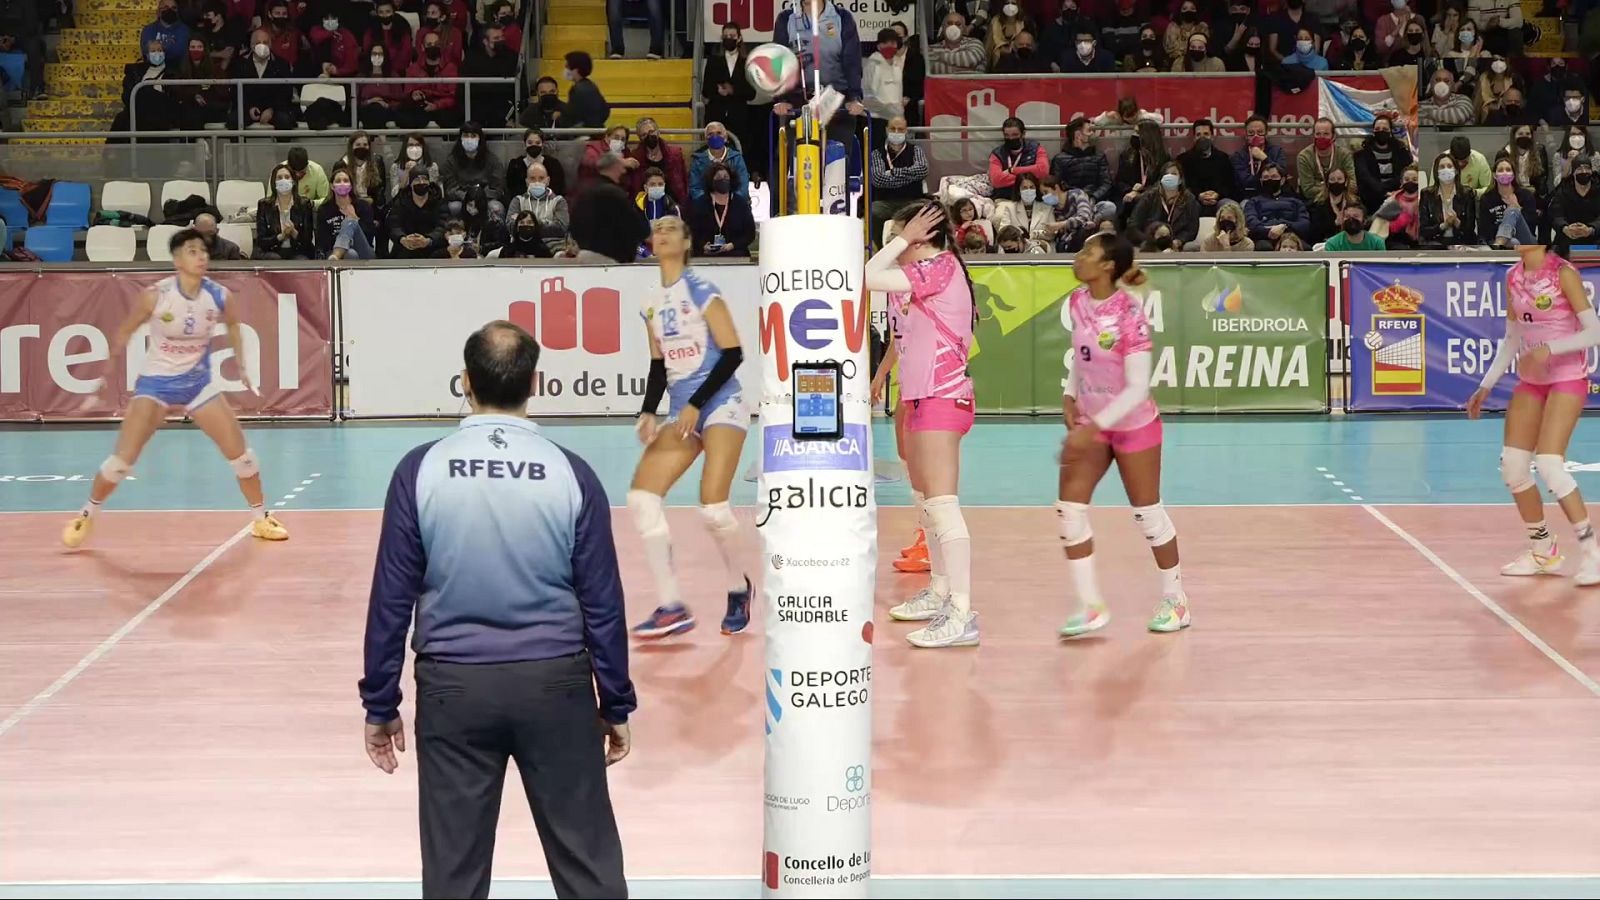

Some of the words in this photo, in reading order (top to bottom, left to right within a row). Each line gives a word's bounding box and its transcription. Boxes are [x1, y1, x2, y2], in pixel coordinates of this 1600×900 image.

[760, 269, 853, 296] VOLEIBOL
[1211, 317, 1308, 332] IBERDROLA
[1378, 319, 1418, 330] RFEVB
[1080, 345, 1091, 362] 9
[1184, 345, 1310, 388] REINA
[572, 371, 606, 397] de
[616, 372, 646, 397] Lu
[448, 458, 547, 481] RFEVB
[756, 477, 868, 527] galicia
[786, 557, 828, 567] Xacobeo
[778, 595, 832, 609] GALICIA
[778, 609, 848, 623] SAUDABLE
[791, 666, 872, 687] DEPORTE
[791, 688, 868, 708] GALEGO
[784, 855, 845, 870] Concello
[848, 852, 862, 867] de
[783, 874, 835, 885] Concellería
[837, 874, 848, 884] de
